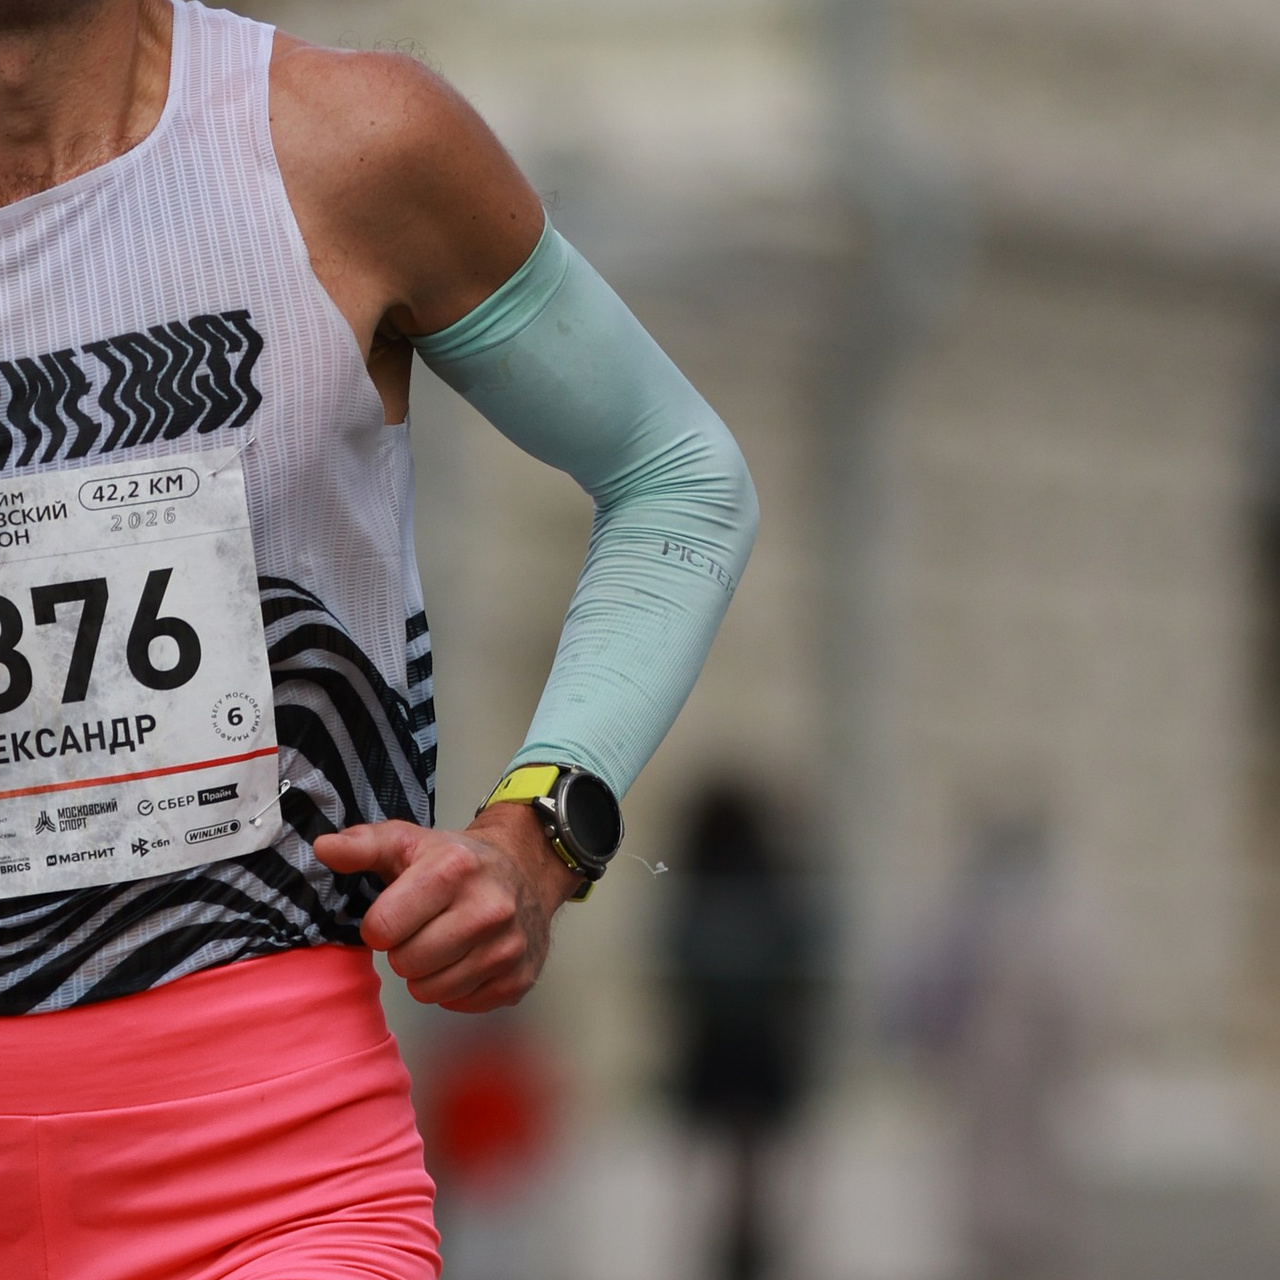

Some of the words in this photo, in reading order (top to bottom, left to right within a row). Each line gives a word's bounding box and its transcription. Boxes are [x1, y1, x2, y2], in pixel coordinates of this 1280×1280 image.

[92, 481, 139, 502] 42,2
[111, 507, 176, 532] 2026
[225, 692, 261, 733] МОСКОВСКИЙ
[227, 707, 243, 726] 6
[57, 798, 118, 819] МОСКОВСКИЙ
[157, 795, 195, 810] СБЕР
[202, 789, 232, 802] Прайм
[59, 817, 87, 832] СПОРТ
[189, 825, 228, 841] WINLINE
[0, 862, 31, 874] BRICS
